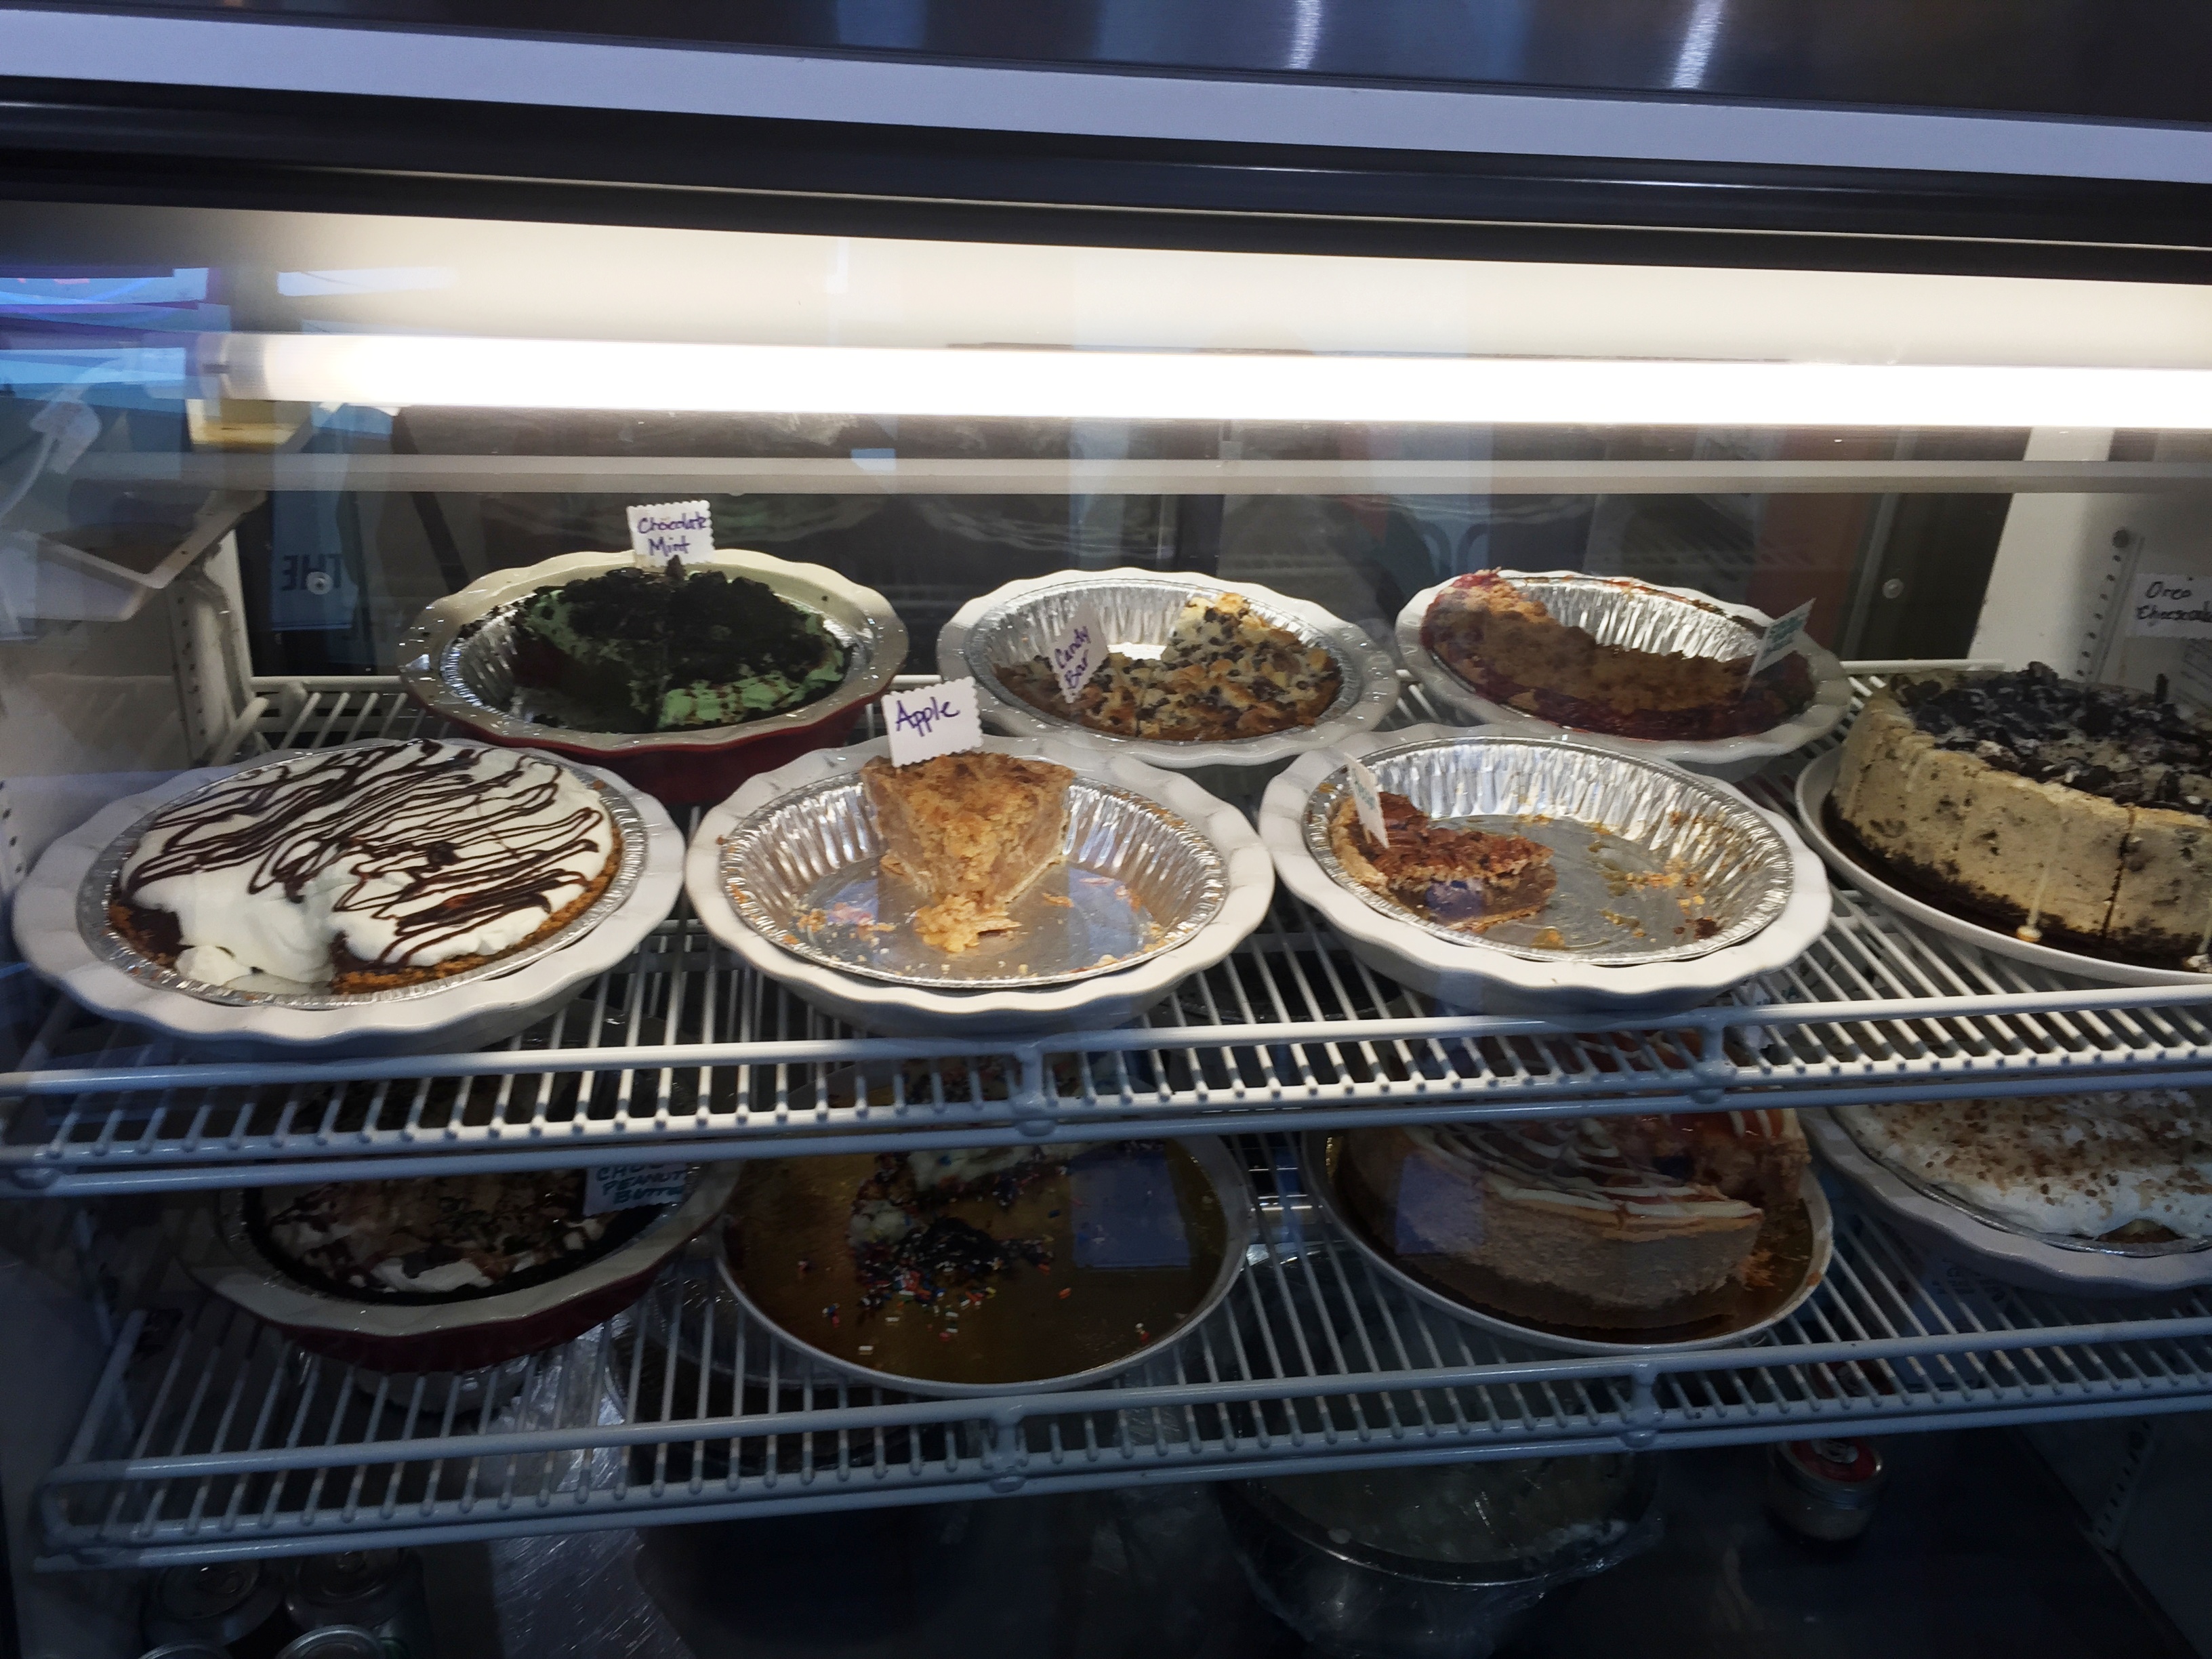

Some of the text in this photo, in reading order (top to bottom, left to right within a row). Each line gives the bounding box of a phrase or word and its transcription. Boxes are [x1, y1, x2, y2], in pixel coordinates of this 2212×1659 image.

[637, 511, 706, 534] Chocolate
[648, 535, 690, 556] Mint
[2146, 581, 2192, 600] Oreo
[896, 696, 960, 737] Apple
